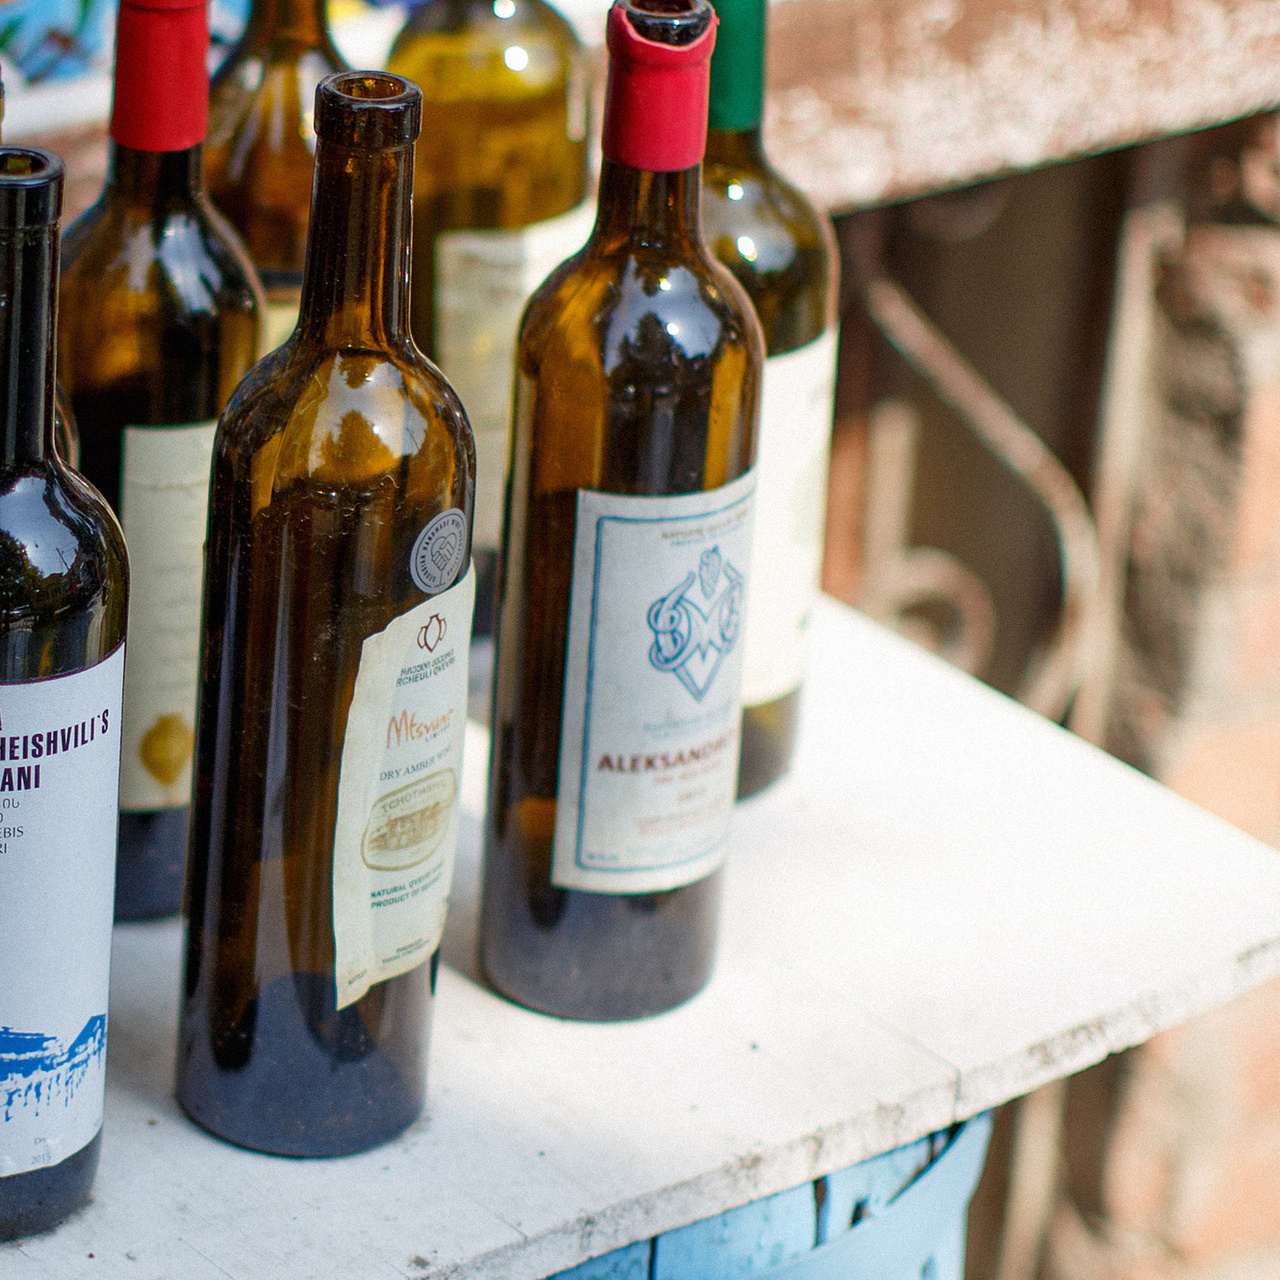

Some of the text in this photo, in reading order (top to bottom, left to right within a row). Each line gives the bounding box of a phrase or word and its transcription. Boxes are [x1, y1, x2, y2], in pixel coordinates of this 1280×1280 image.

[380, 768, 401, 780] DRY
[371, 883, 406, 898] NATURAL
[371, 892, 410, 909] PRODUCT
